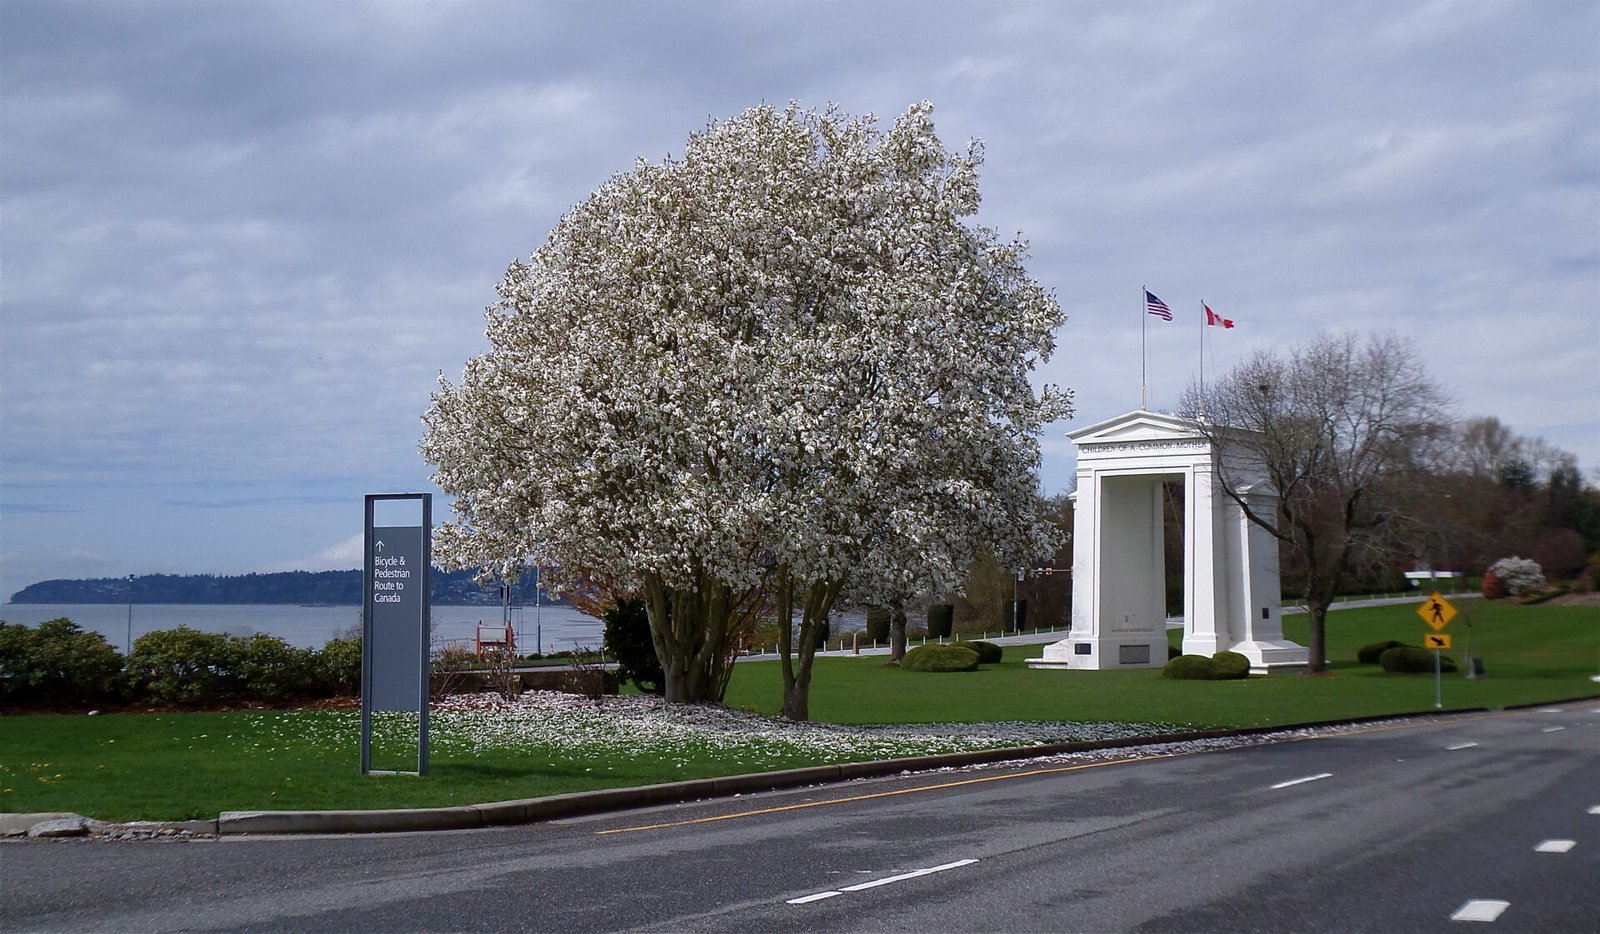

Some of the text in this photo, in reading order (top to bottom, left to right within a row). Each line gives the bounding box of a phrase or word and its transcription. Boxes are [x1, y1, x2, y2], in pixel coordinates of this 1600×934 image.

[1119, 444, 1127, 452] OF
[1138, 441, 1172, 450] COMMON
[1176, 441, 1207, 449] MOTHER
[374, 556, 405, 568] Bicycle &
[374, 568, 410, 577] Pedestrian
[374, 581, 403, 590] Route to
[374, 593, 400, 602] Canada
